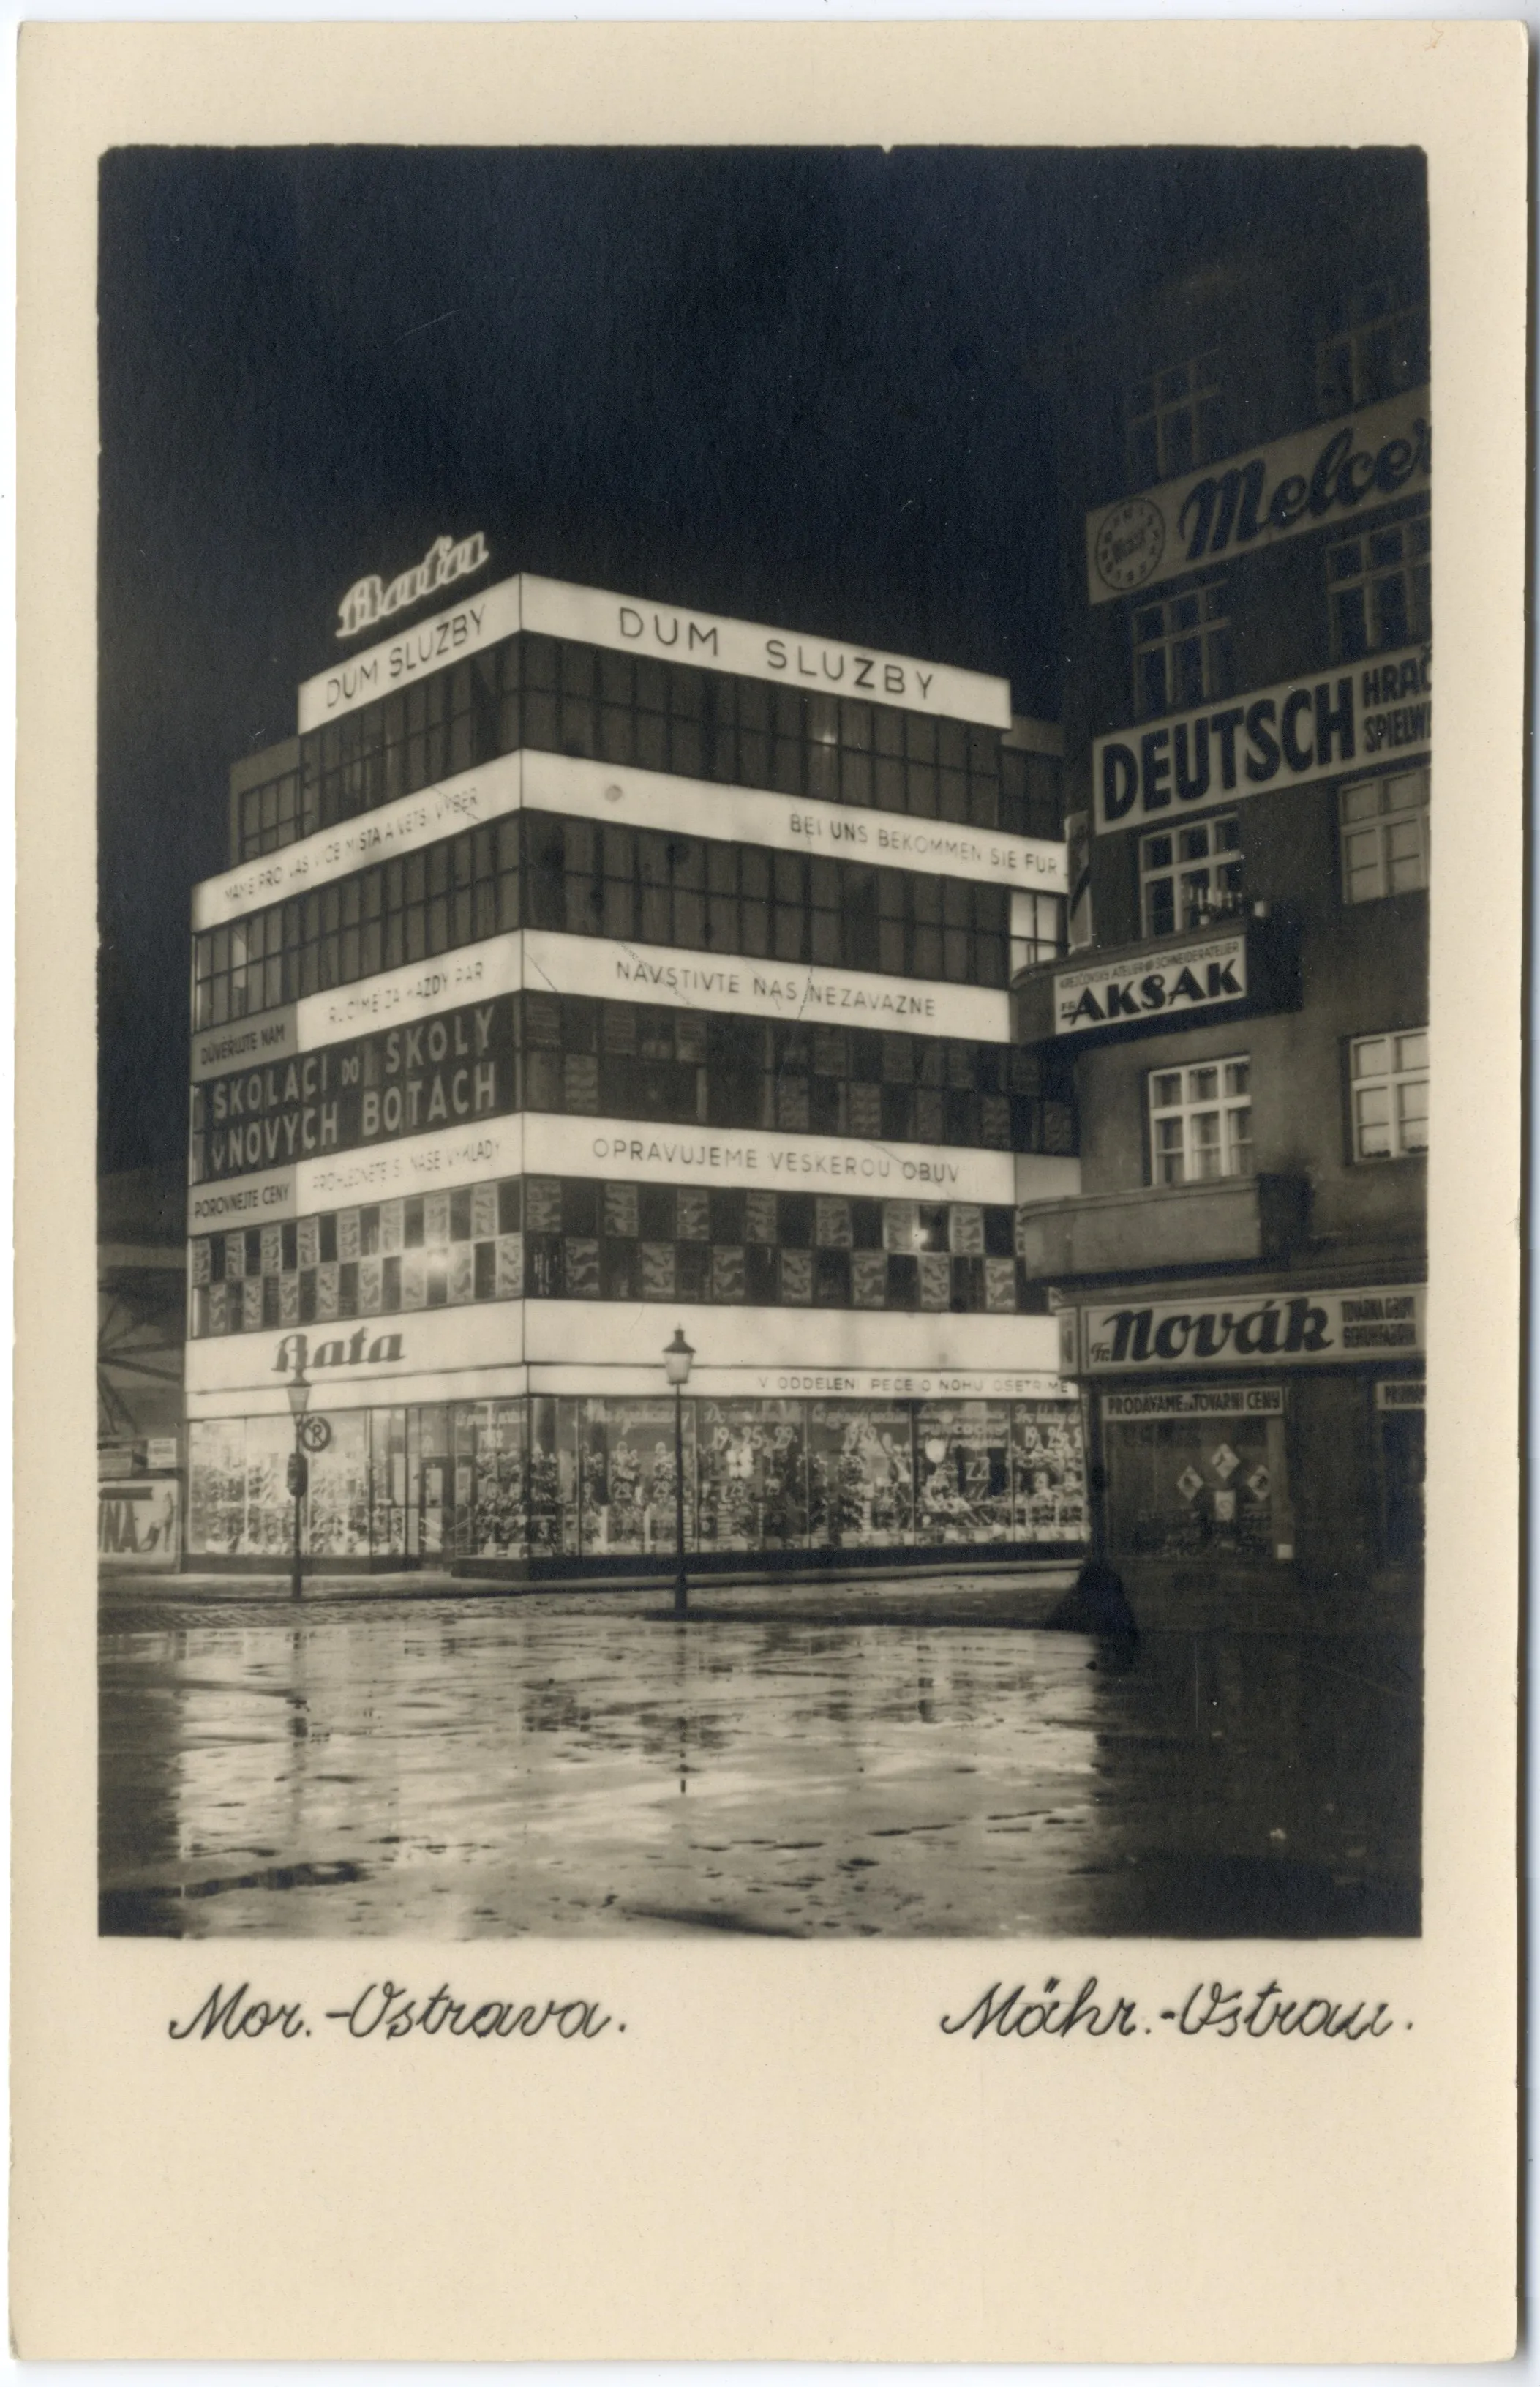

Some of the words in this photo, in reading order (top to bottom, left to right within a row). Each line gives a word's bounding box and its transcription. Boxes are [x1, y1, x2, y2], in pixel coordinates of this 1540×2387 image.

[326, 662, 378, 708] DUM
[388, 602, 487, 678] SLUZBY
[617, 605, 720, 657] DUM
[765, 639, 934, 700] SLUZBY
[1102, 673, 1356, 822] DEUTSCH
[829, 820, 869, 844] UNS
[989, 847, 1018, 870] SIE
[361, 1058, 497, 1138] BOTACH
[592, 1138, 759, 1171] OPRAVUJEME
[771, 1151, 892, 1179] VESKEROU
[901, 1161, 961, 1184] OBUV
